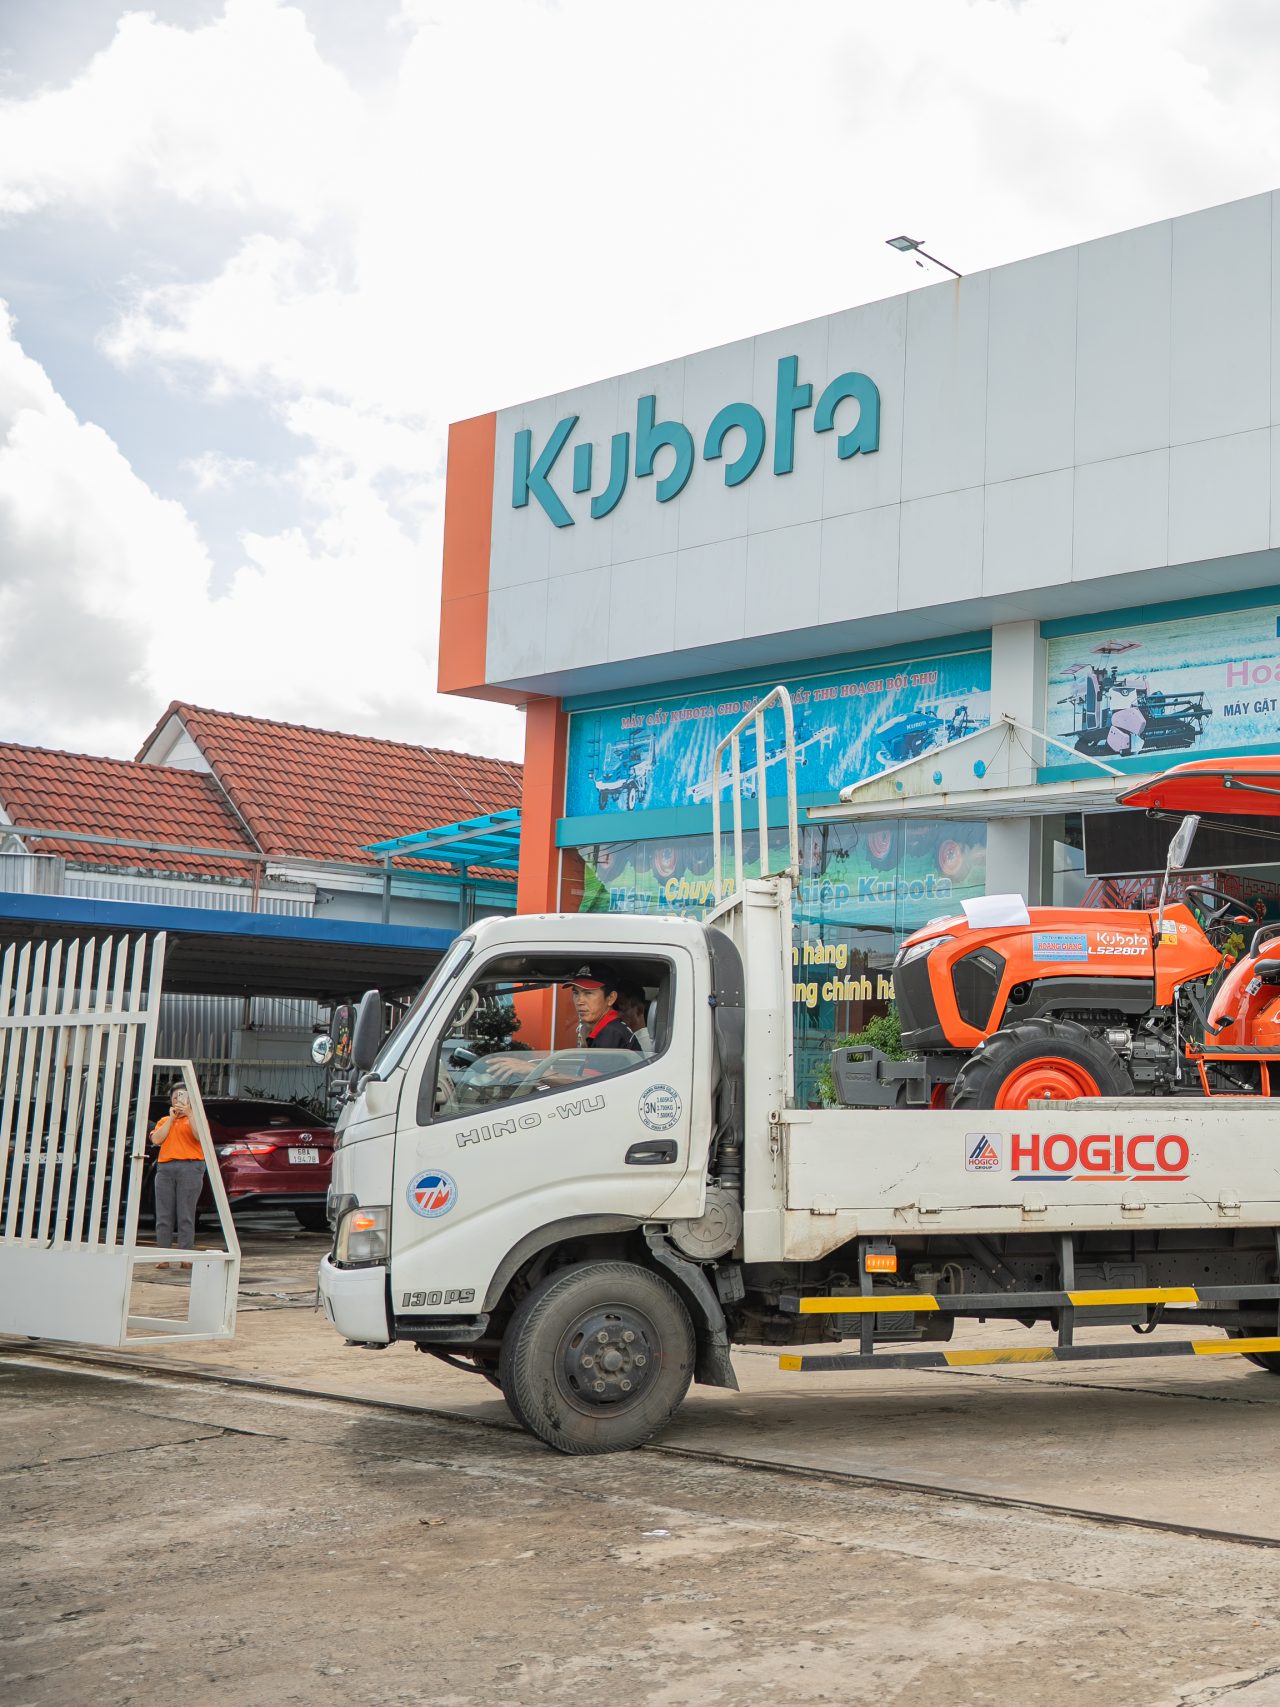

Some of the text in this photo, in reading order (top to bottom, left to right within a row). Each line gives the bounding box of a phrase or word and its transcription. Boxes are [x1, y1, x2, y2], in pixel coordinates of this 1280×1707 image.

[512, 354, 881, 528] Kubota
[621, 713, 645, 729] MÁY
[670, 705, 714, 722] KUBOTA
[717, 701, 740, 716] CHO
[813, 687, 836, 701] THU
[840, 681, 884, 698] HOẠCH
[910, 671, 938, 687] THU
[1223, 702, 1250, 717] MÁY
[1254, 697, 1277, 716] GẶT
[665, 877, 734, 904] Chuyn
[858, 873, 953, 904] Kubota
[1097, 932, 1148, 946] Kubota
[803, 939, 848, 969] hàng
[822, 974, 872, 1001] chính
[645, 1102, 656, 1113] 3N
[968, 1158, 999, 1166] HOGICO
[1011, 1133, 1190, 1173] HOGICO
